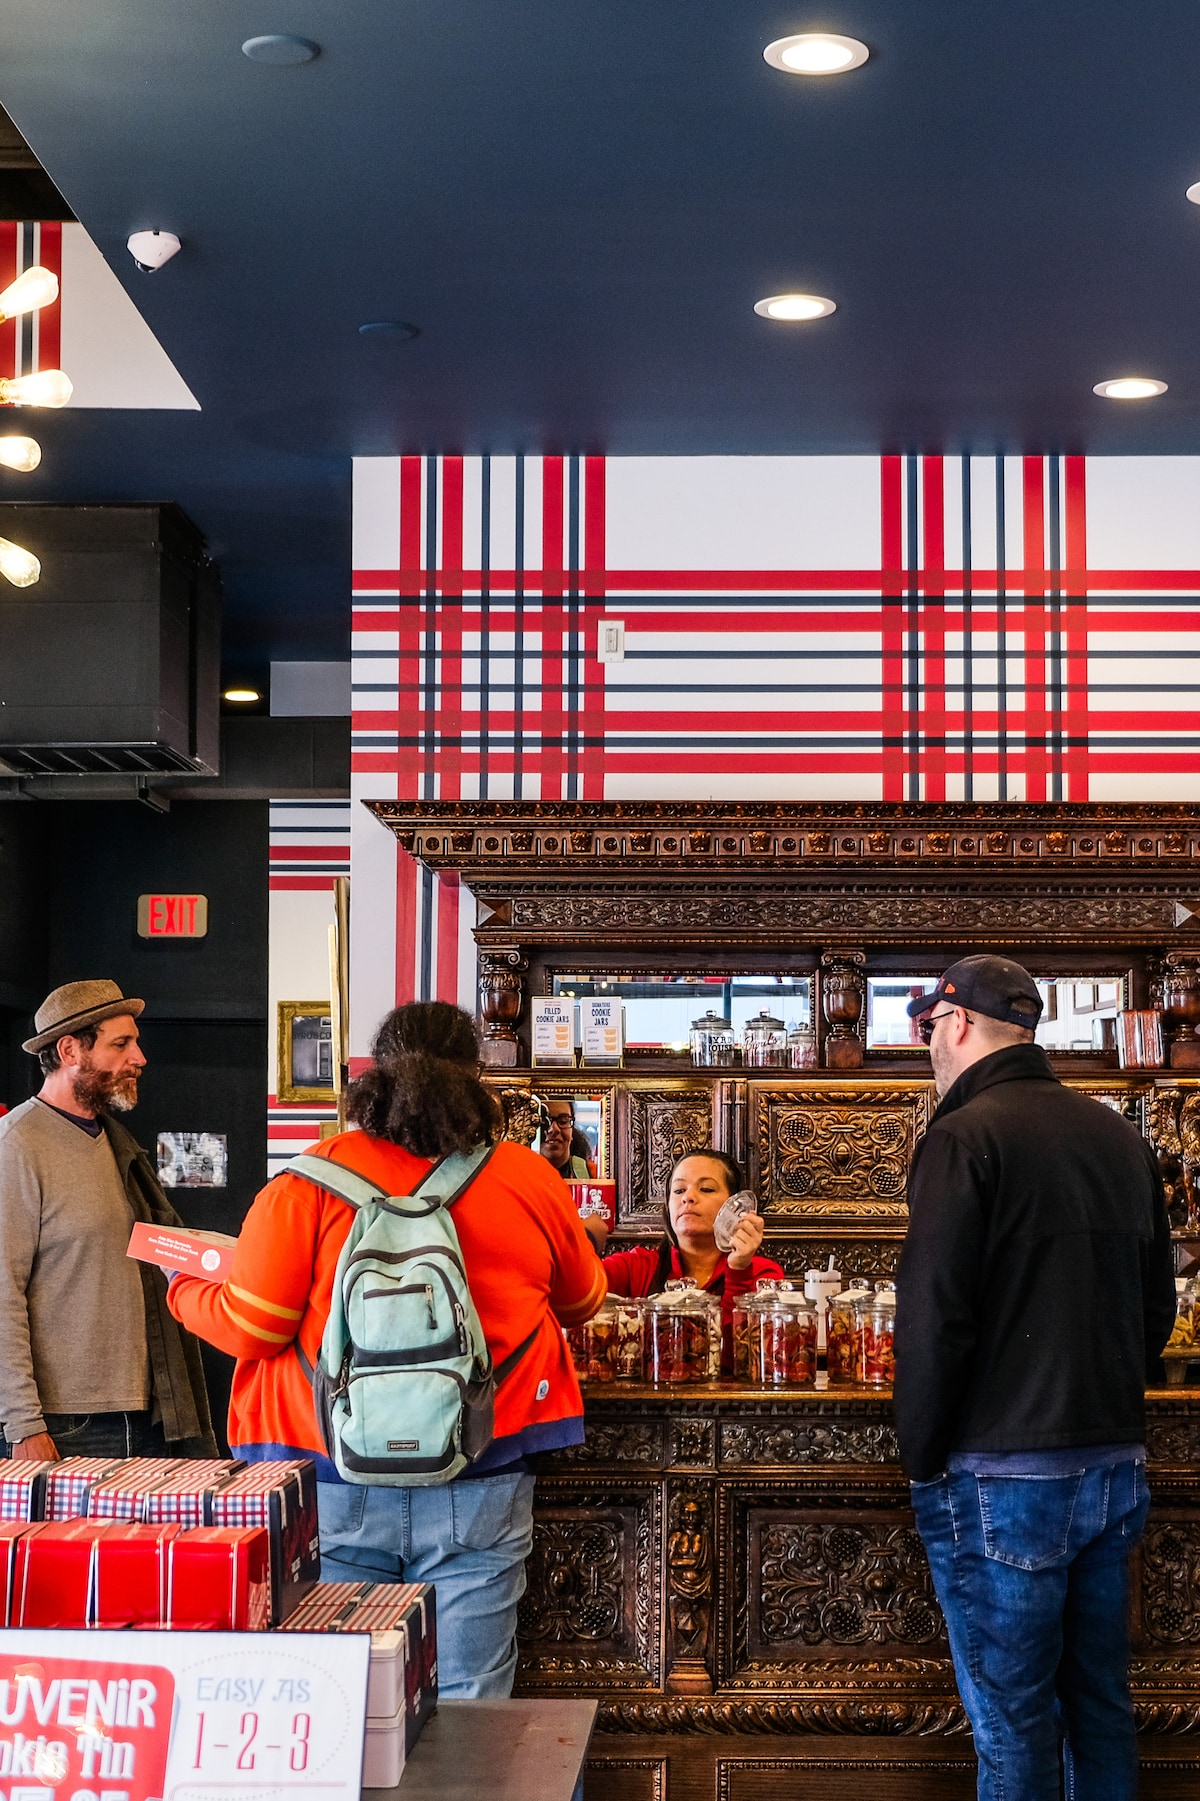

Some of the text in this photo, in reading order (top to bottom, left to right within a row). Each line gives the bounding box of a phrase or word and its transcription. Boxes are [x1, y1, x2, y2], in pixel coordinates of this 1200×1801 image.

[148, 896, 198, 935] EXIT
[536, 1015, 570, 1023] COOKIE JARS
[544, 1007, 561, 1015] FILLED
[591, 1008, 611, 1017] COOKIE
[594, 1017, 609, 1026] JARS
[196, 1677, 311, 1707] EASY AS
[192, 1711, 311, 1772] 1-2-3
[77, 1733, 135, 1780] Tin
